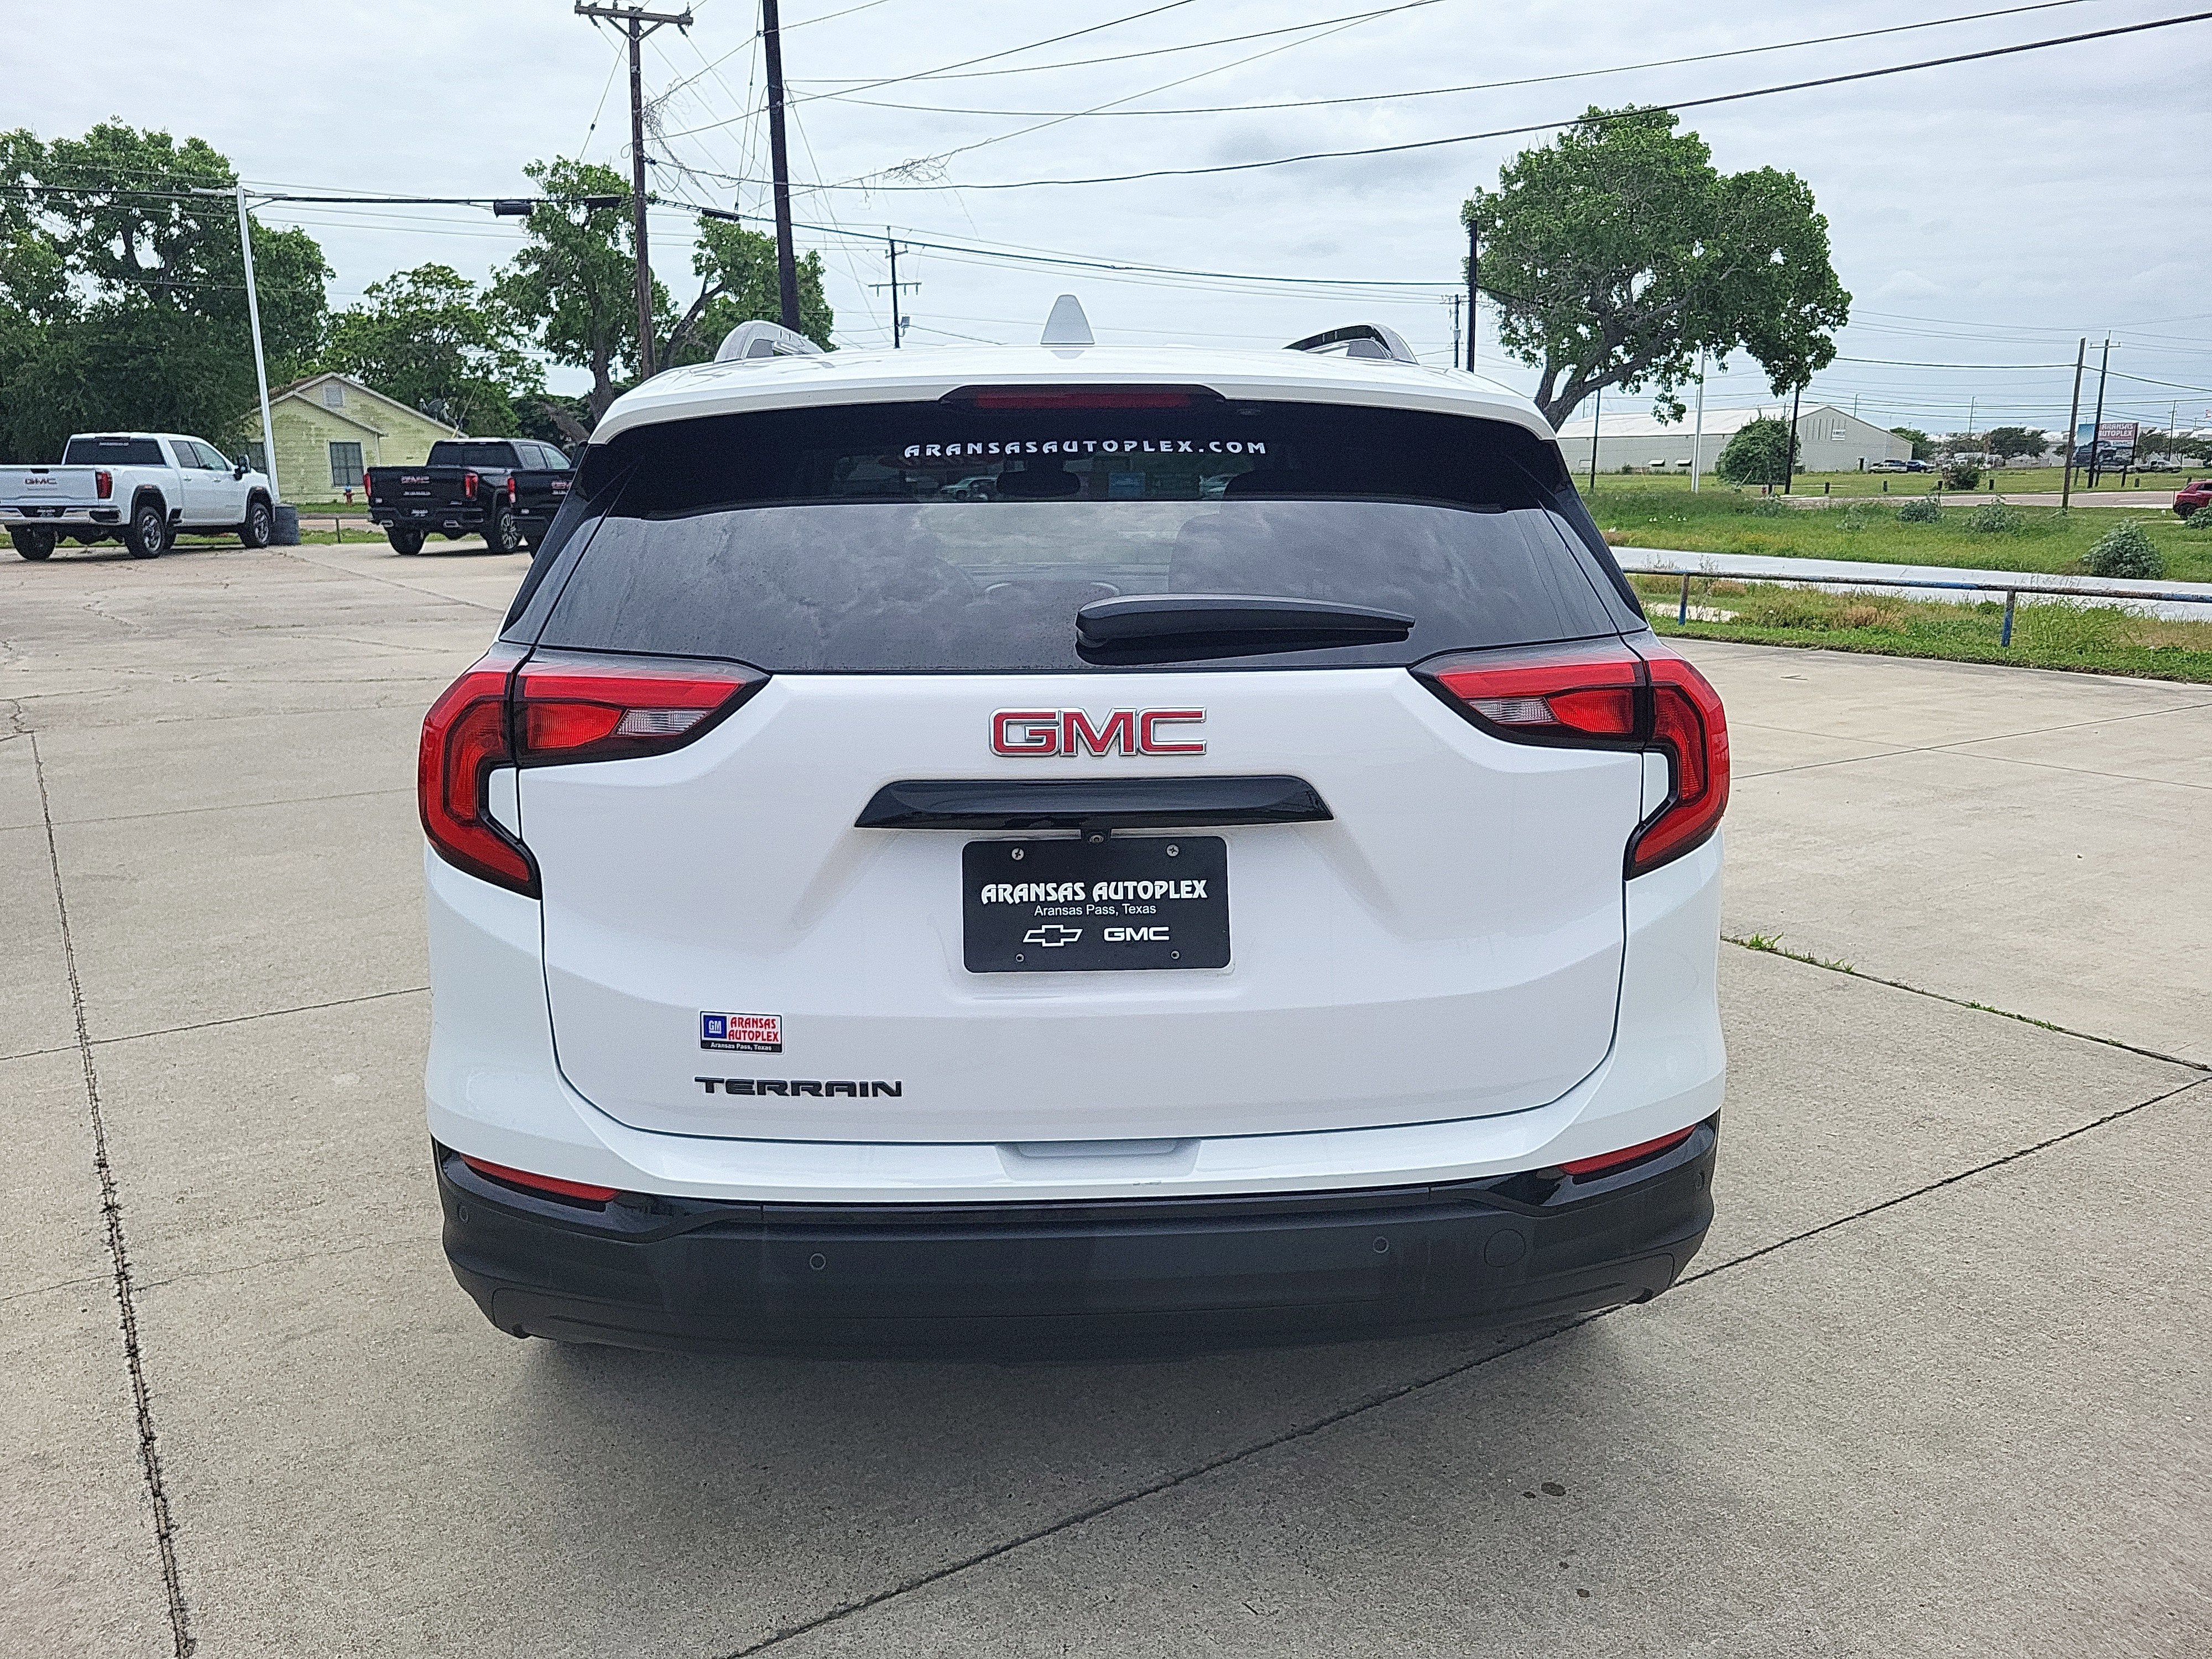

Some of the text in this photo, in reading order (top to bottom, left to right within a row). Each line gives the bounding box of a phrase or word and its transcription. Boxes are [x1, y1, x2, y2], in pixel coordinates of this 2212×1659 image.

[904, 440, 1266, 458] ARANSASAUTOPLEX.COM
[989, 707, 1207, 757] GMC
[980, 879, 1208, 905] ARANSAS AUTOPLEX
[1034, 903, 1156, 917] Aransas Pass, Texas
[1104, 926, 1170, 941] GMC
[708, 1020, 722, 1034] GM
[730, 1016, 776, 1030] ARANSAS
[728, 1029, 779, 1042] AUTOPLEX
[694, 1076, 902, 1098] TERRAIN
